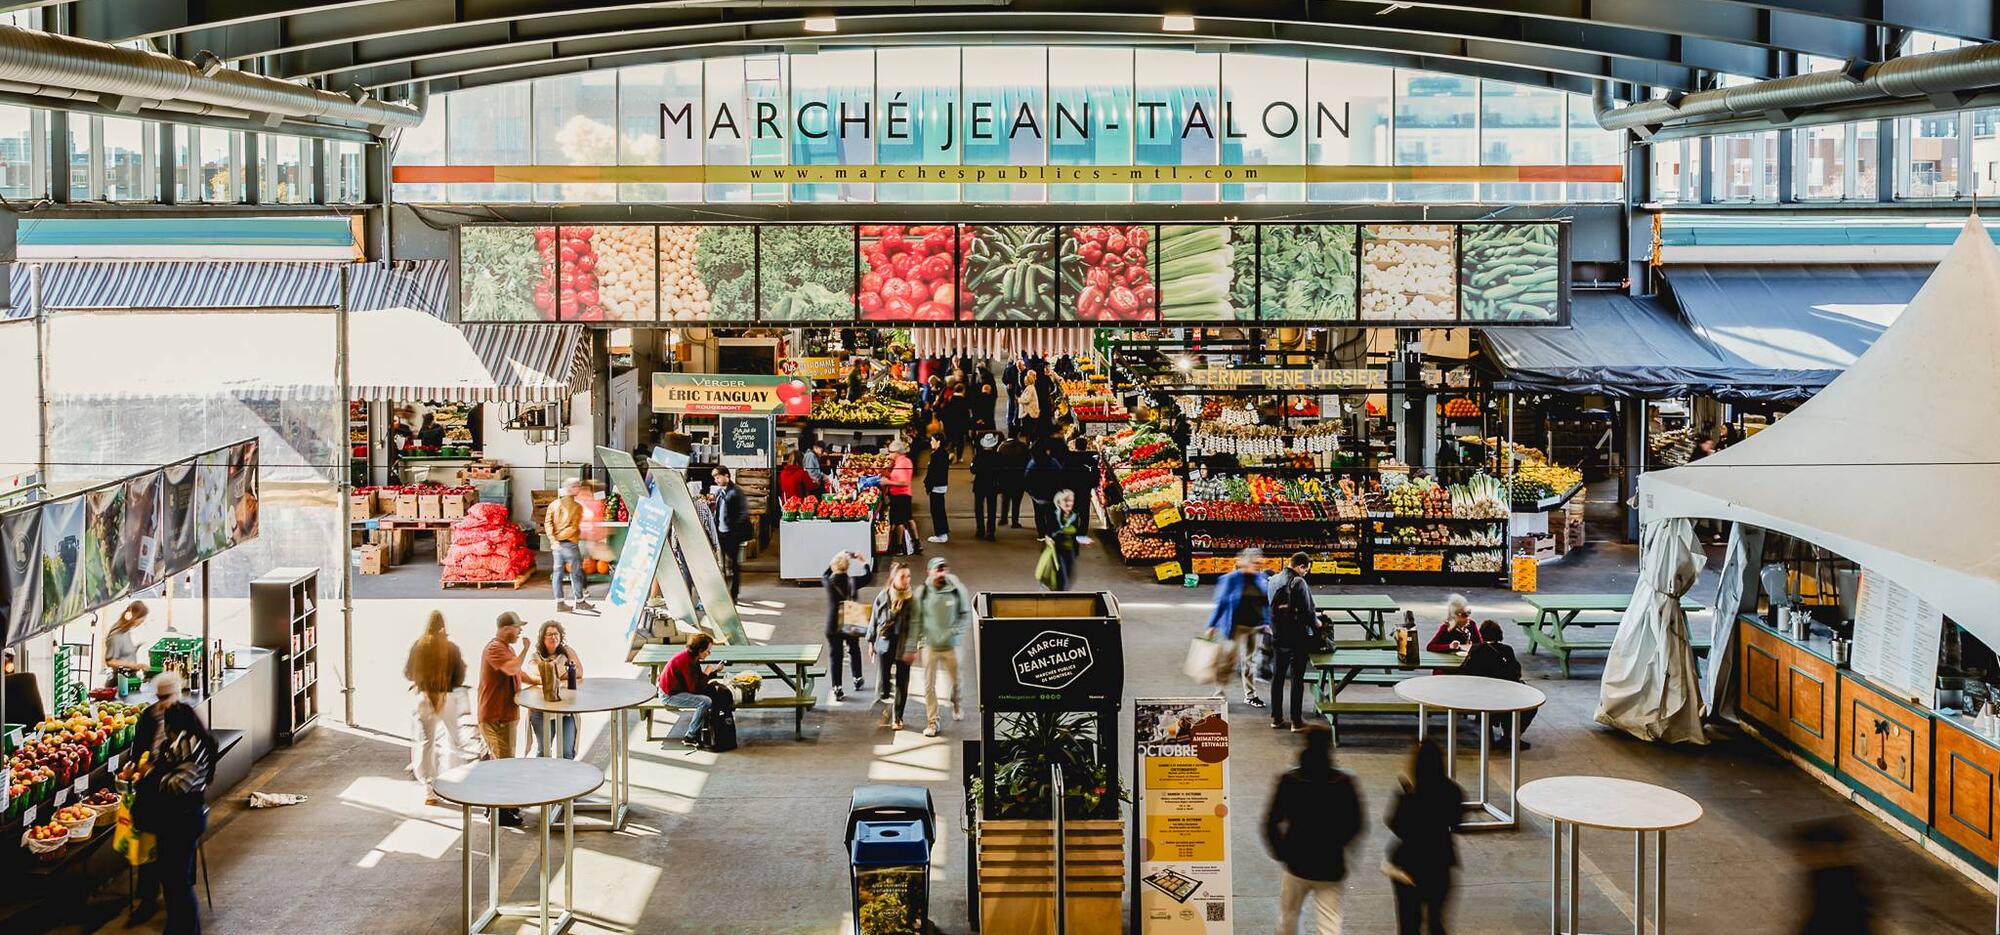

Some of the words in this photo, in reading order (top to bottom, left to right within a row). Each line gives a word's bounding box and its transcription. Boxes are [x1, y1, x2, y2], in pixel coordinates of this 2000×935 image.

[660, 91, 908, 139] MARCHÉ
[941, 102, 1349, 151] JEAN-TALON
[750, 166, 1257, 182] www.marchespublics-mtl.com
[691, 377, 746, 387] VERGER
[1197, 370, 1253, 385] FERME
[1311, 370, 1379, 385] LUSSIER
[669, 387, 701, 401] ÉRIC
[705, 391, 769, 403] TANGUAY
[1027, 638, 1070, 657] MARCHÉ
[1018, 646, 1087, 674] JEAN-TALON
[1137, 744, 1198, 757] OCTOBRE
